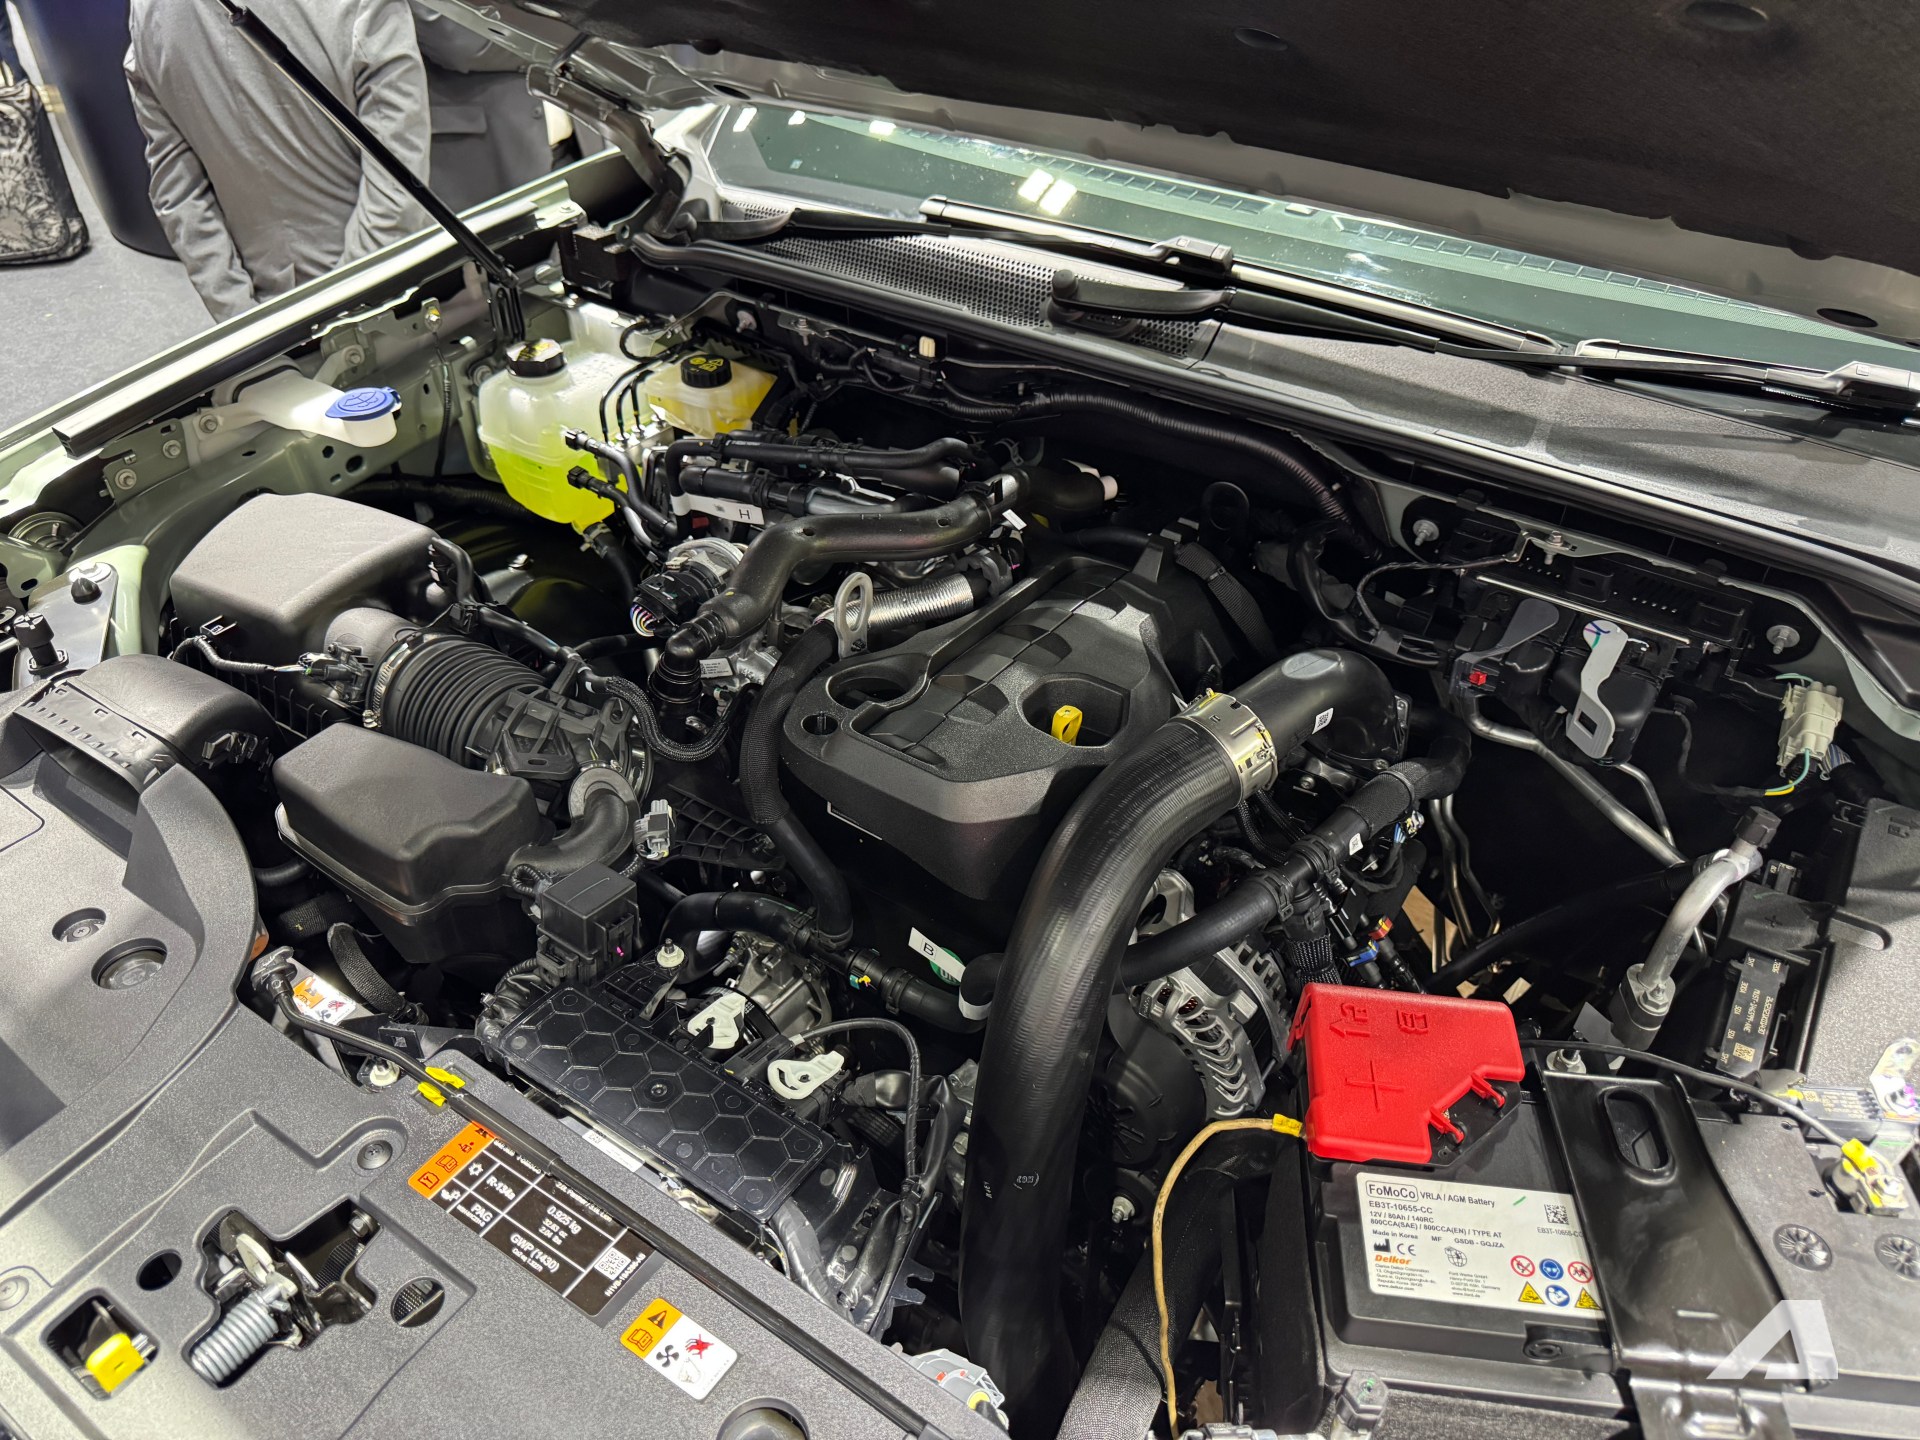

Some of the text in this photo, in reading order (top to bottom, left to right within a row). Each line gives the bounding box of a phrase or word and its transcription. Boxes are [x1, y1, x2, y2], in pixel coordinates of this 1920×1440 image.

[739, 509, 751, 520] H
[923, 942, 934, 956] B
[486, 1175, 516, 1200] R-134a
[1368, 1184, 1416, 1199] FoMoCo
[1420, 1191, 1442, 1201] VRLA
[1447, 1194, 1466, 1203] AGM
[1468, 1196, 1495, 1209] Battery
[470, 1203, 494, 1223] PAG
[1369, 1200, 1433, 1214] EB3T-10655-CC
[547, 1205, 582, 1235] 0.925 kg
[1370, 1210, 1382, 1218] 12V
[1412, 1215, 1435, 1224] 140RC
[538, 1226, 553, 1239] 2.04
[1370, 1218, 1418, 1230] 800CCA(SAE)
[1424, 1223, 1467, 1236] 800CCA(EN)
[1472, 1229, 1491, 1237] TYPE
[1493, 1231, 1502, 1239] AT
[1399, 1231, 1419, 1239] Korea
[510, 1233, 560, 1273] GWP (1430)
[1374, 1254, 1412, 1265] Delkor
